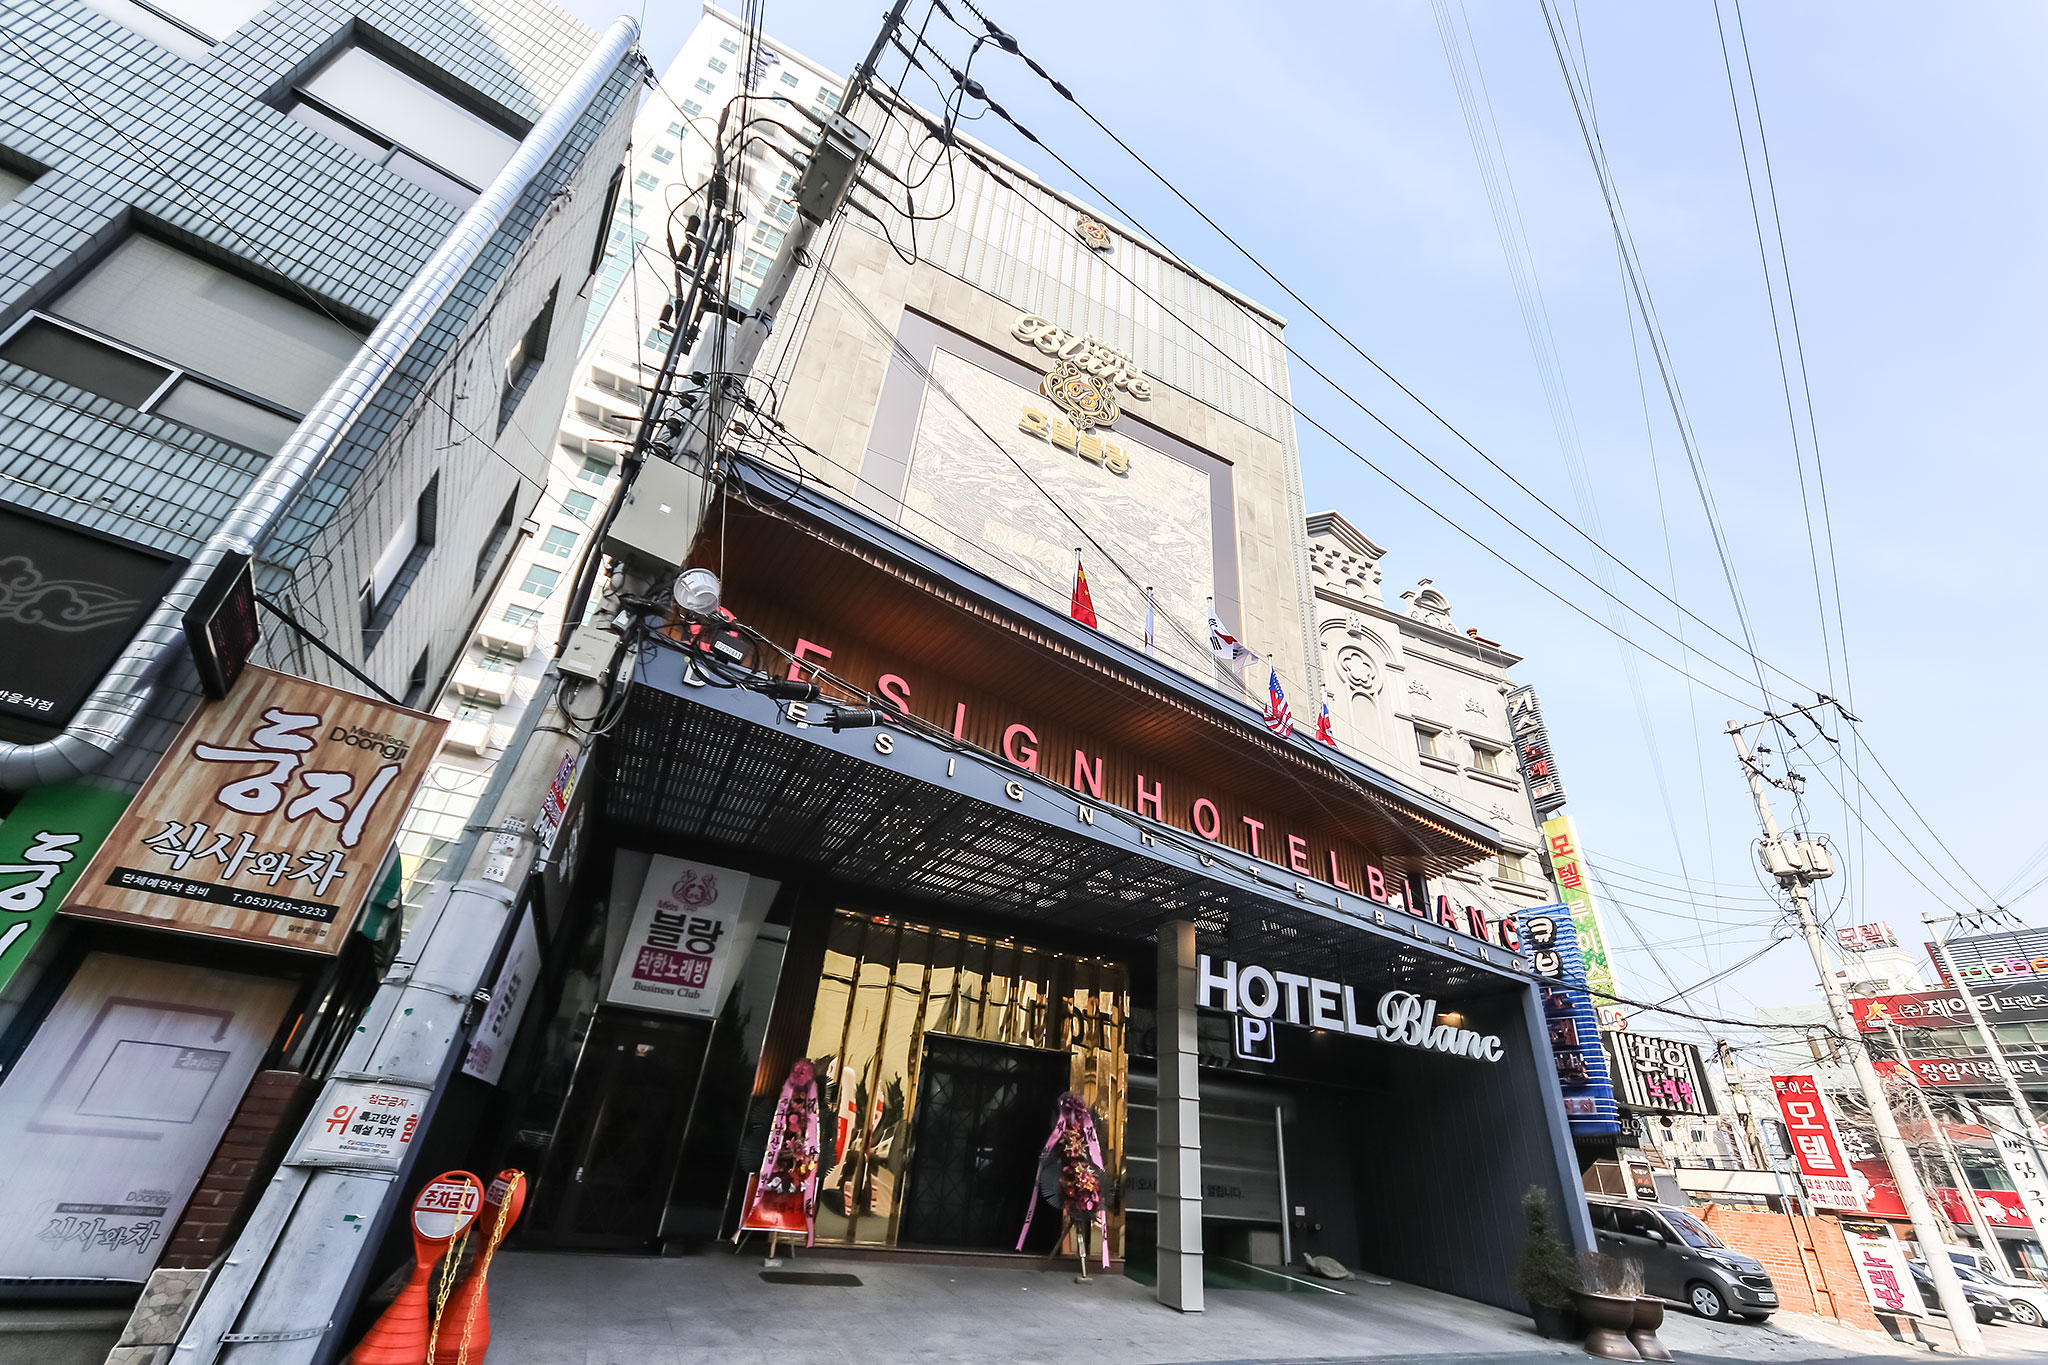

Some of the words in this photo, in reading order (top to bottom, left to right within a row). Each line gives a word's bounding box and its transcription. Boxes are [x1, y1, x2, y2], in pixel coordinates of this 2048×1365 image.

[328, 726, 408, 760] Doongji
[1137, 773, 1349, 889] HOTEL
[1366, 864, 1521, 951] BLANC
[121, 872, 185, 896] 단체예약석
[185, 883, 210, 897] 완비
[231, 892, 329, 918] T.053)743-3233
[1552, 833, 1583, 890] 모텔
[1568, 898, 1609, 987] 루이스
[647, 909, 725, 955] 블랑
[1836, 923, 1887, 949] 모텔
[632, 980, 676, 997] Business
[676, 987, 701, 1000] Club
[1196, 953, 1379, 1039] HOTEL
[1376, 989, 1505, 1063] Blanc
[1242, 1016, 1268, 1054] P
[1635, 1042, 1688, 1079] 포유
[1647, 1076, 1694, 1105] 노래방
[1775, 1080, 1817, 1095] 루이스
[326, 1105, 358, 1135] 위
[351, 1123, 374, 1136] 매설
[374, 1127, 397, 1139] 지역
[360, 1111, 400, 1126] 특고압선
[1786, 1101, 1837, 1170] 모텔
[423, 1189, 477, 1210] 주차금지
[1863, 1250, 1905, 1310] 노래방
